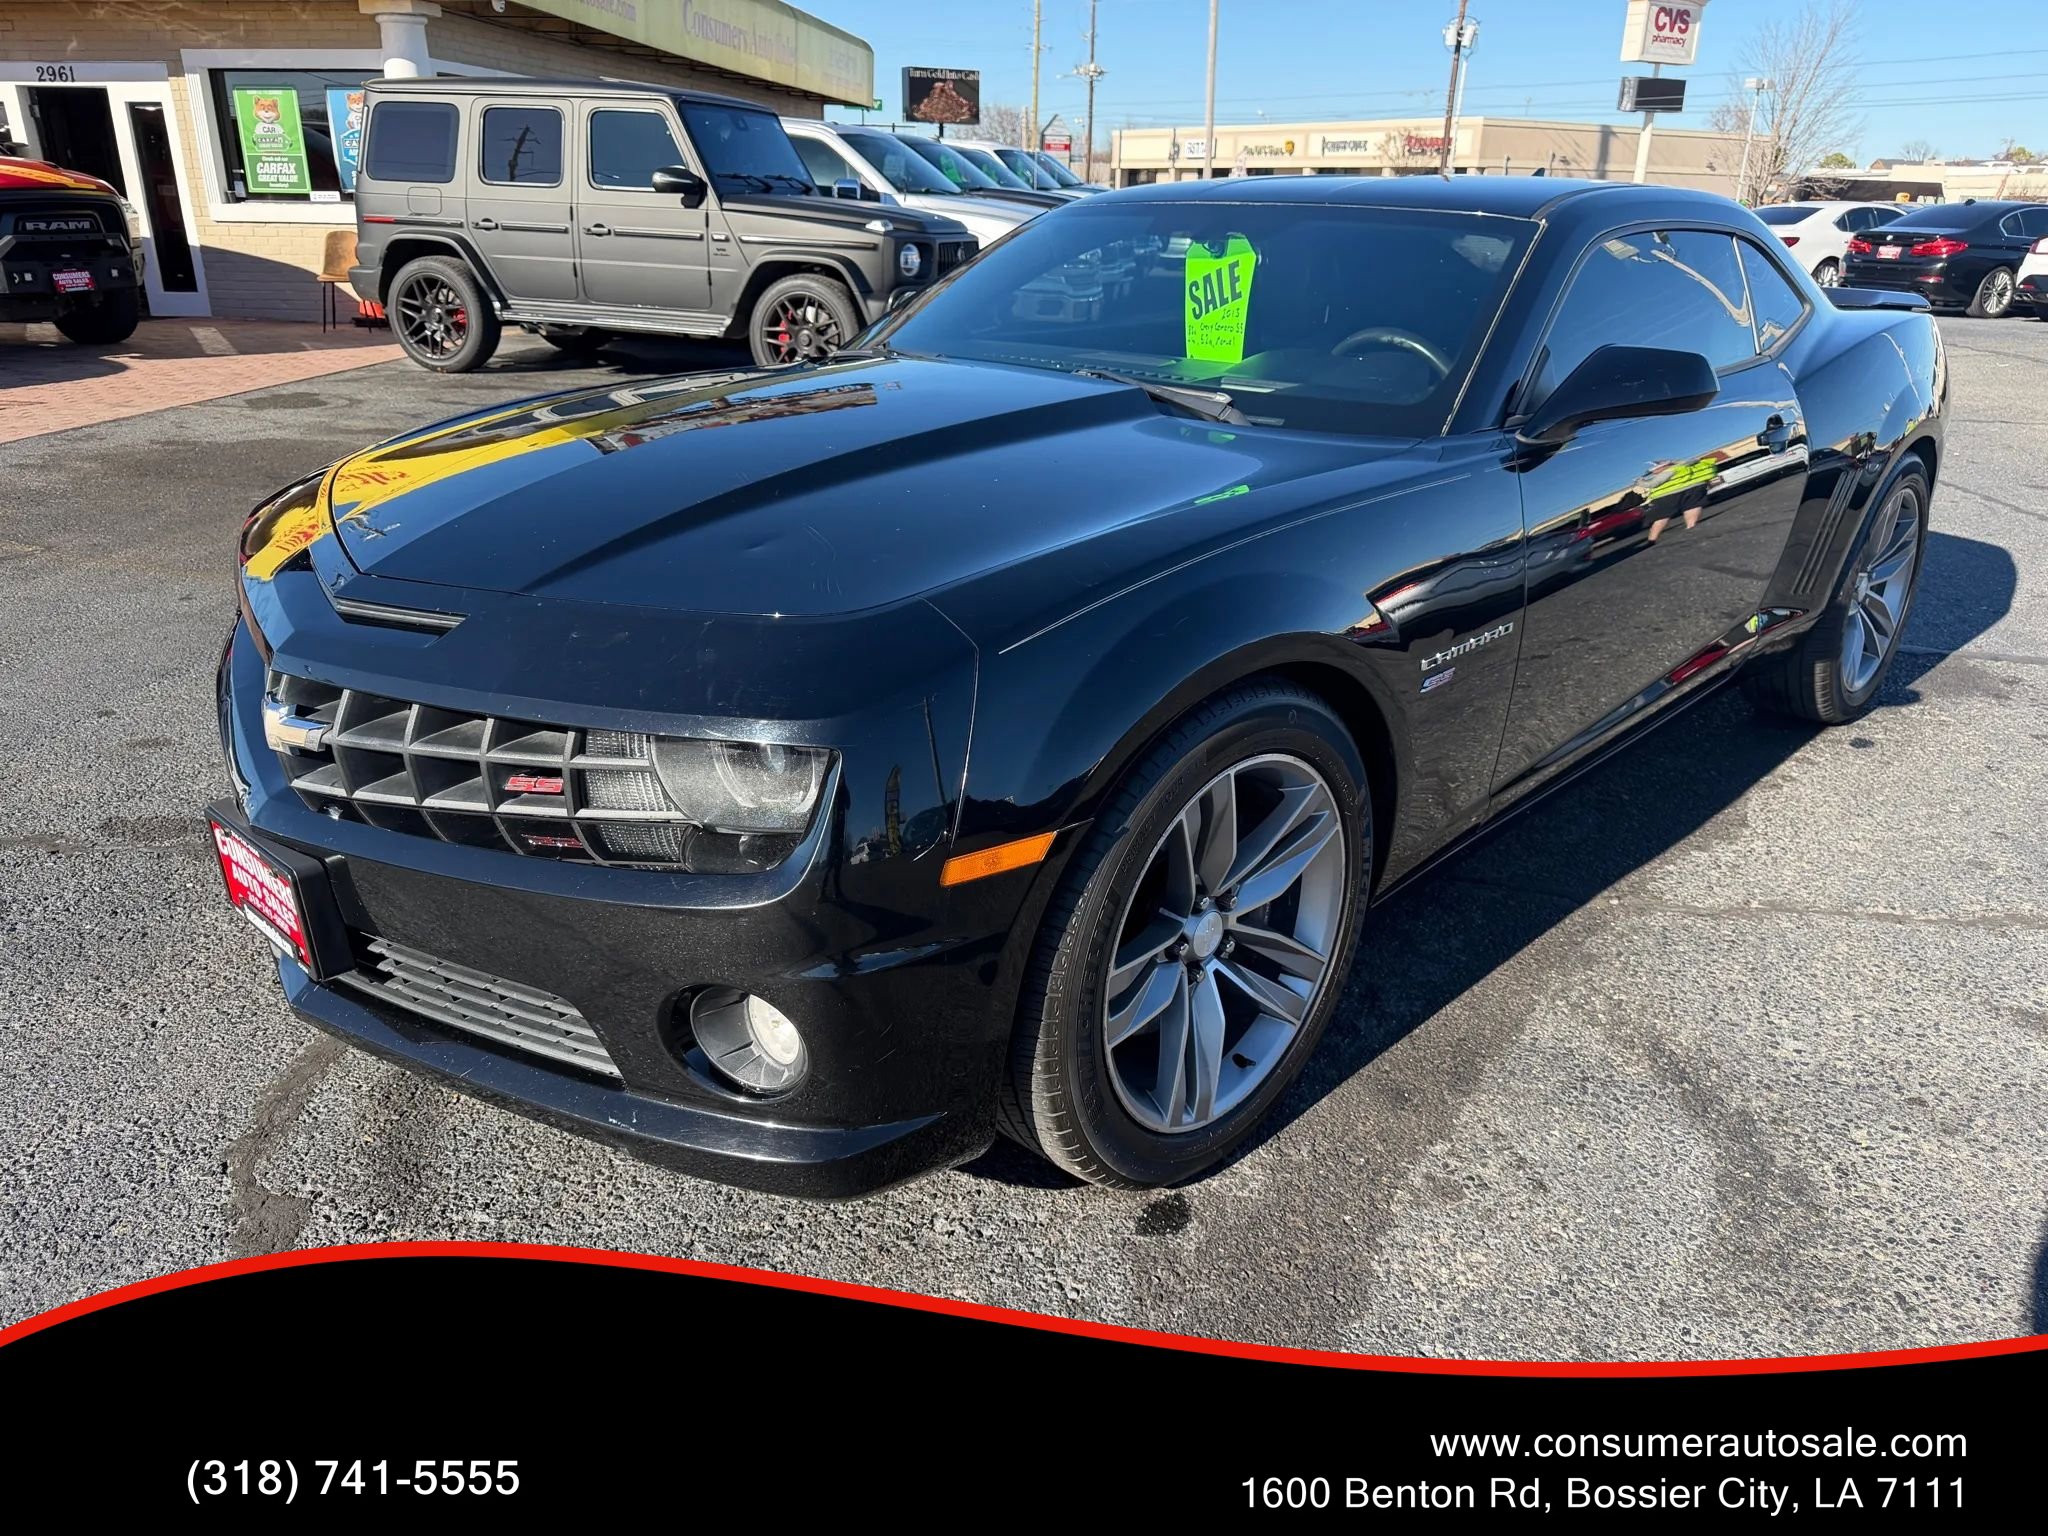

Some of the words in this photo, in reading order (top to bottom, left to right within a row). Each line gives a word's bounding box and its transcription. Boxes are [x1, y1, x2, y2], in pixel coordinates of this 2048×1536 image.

[1655, 6, 1691, 34] CVS
[1652, 34, 1687, 47] pharmacy
[35, 65, 76, 82] 2961
[256, 162, 297, 174] CARFAX
[25, 221, 92, 231] RAM
[1188, 260, 1242, 320] SALE
[1421, 622, 1514, 671] CAMARO
[504, 775, 564, 793] SS
[214, 828, 298, 917] CONSUMERS
[231, 862, 263, 899] AUTO
[263, 889, 299, 932] SALES
